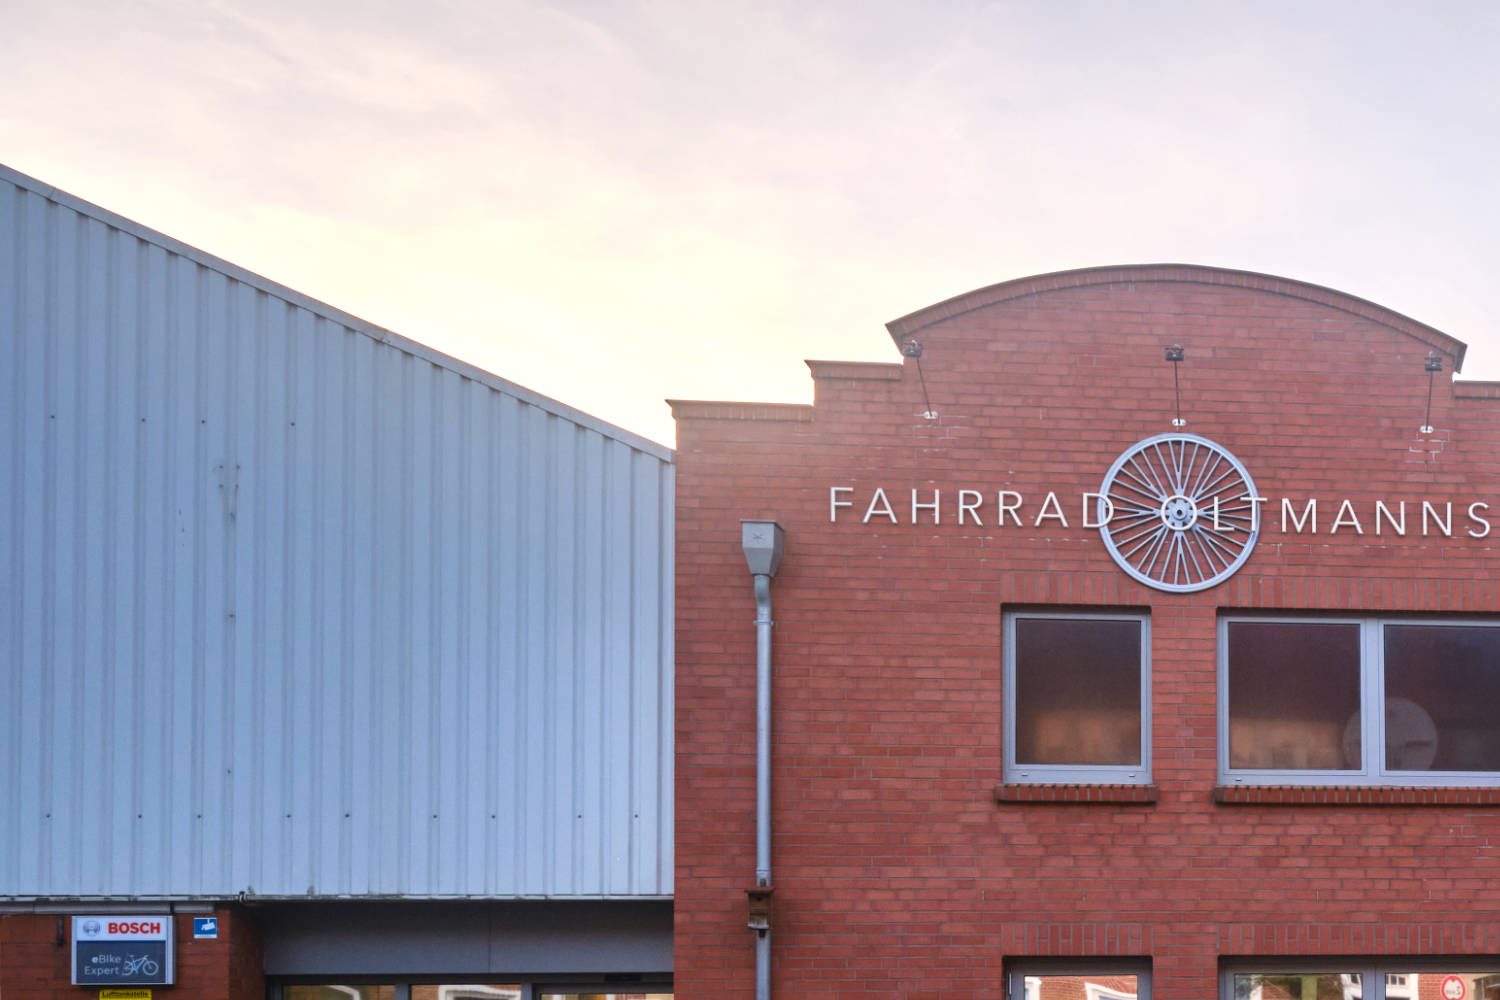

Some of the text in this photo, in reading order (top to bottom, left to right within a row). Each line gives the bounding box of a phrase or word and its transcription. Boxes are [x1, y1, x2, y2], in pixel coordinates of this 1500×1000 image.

[830, 487, 1491, 539] FAHRRAD OLTMANNS
[108, 922, 161, 934] BOSCH
[91, 954, 121, 964] eBike
[84, 965, 119, 976] Expert
